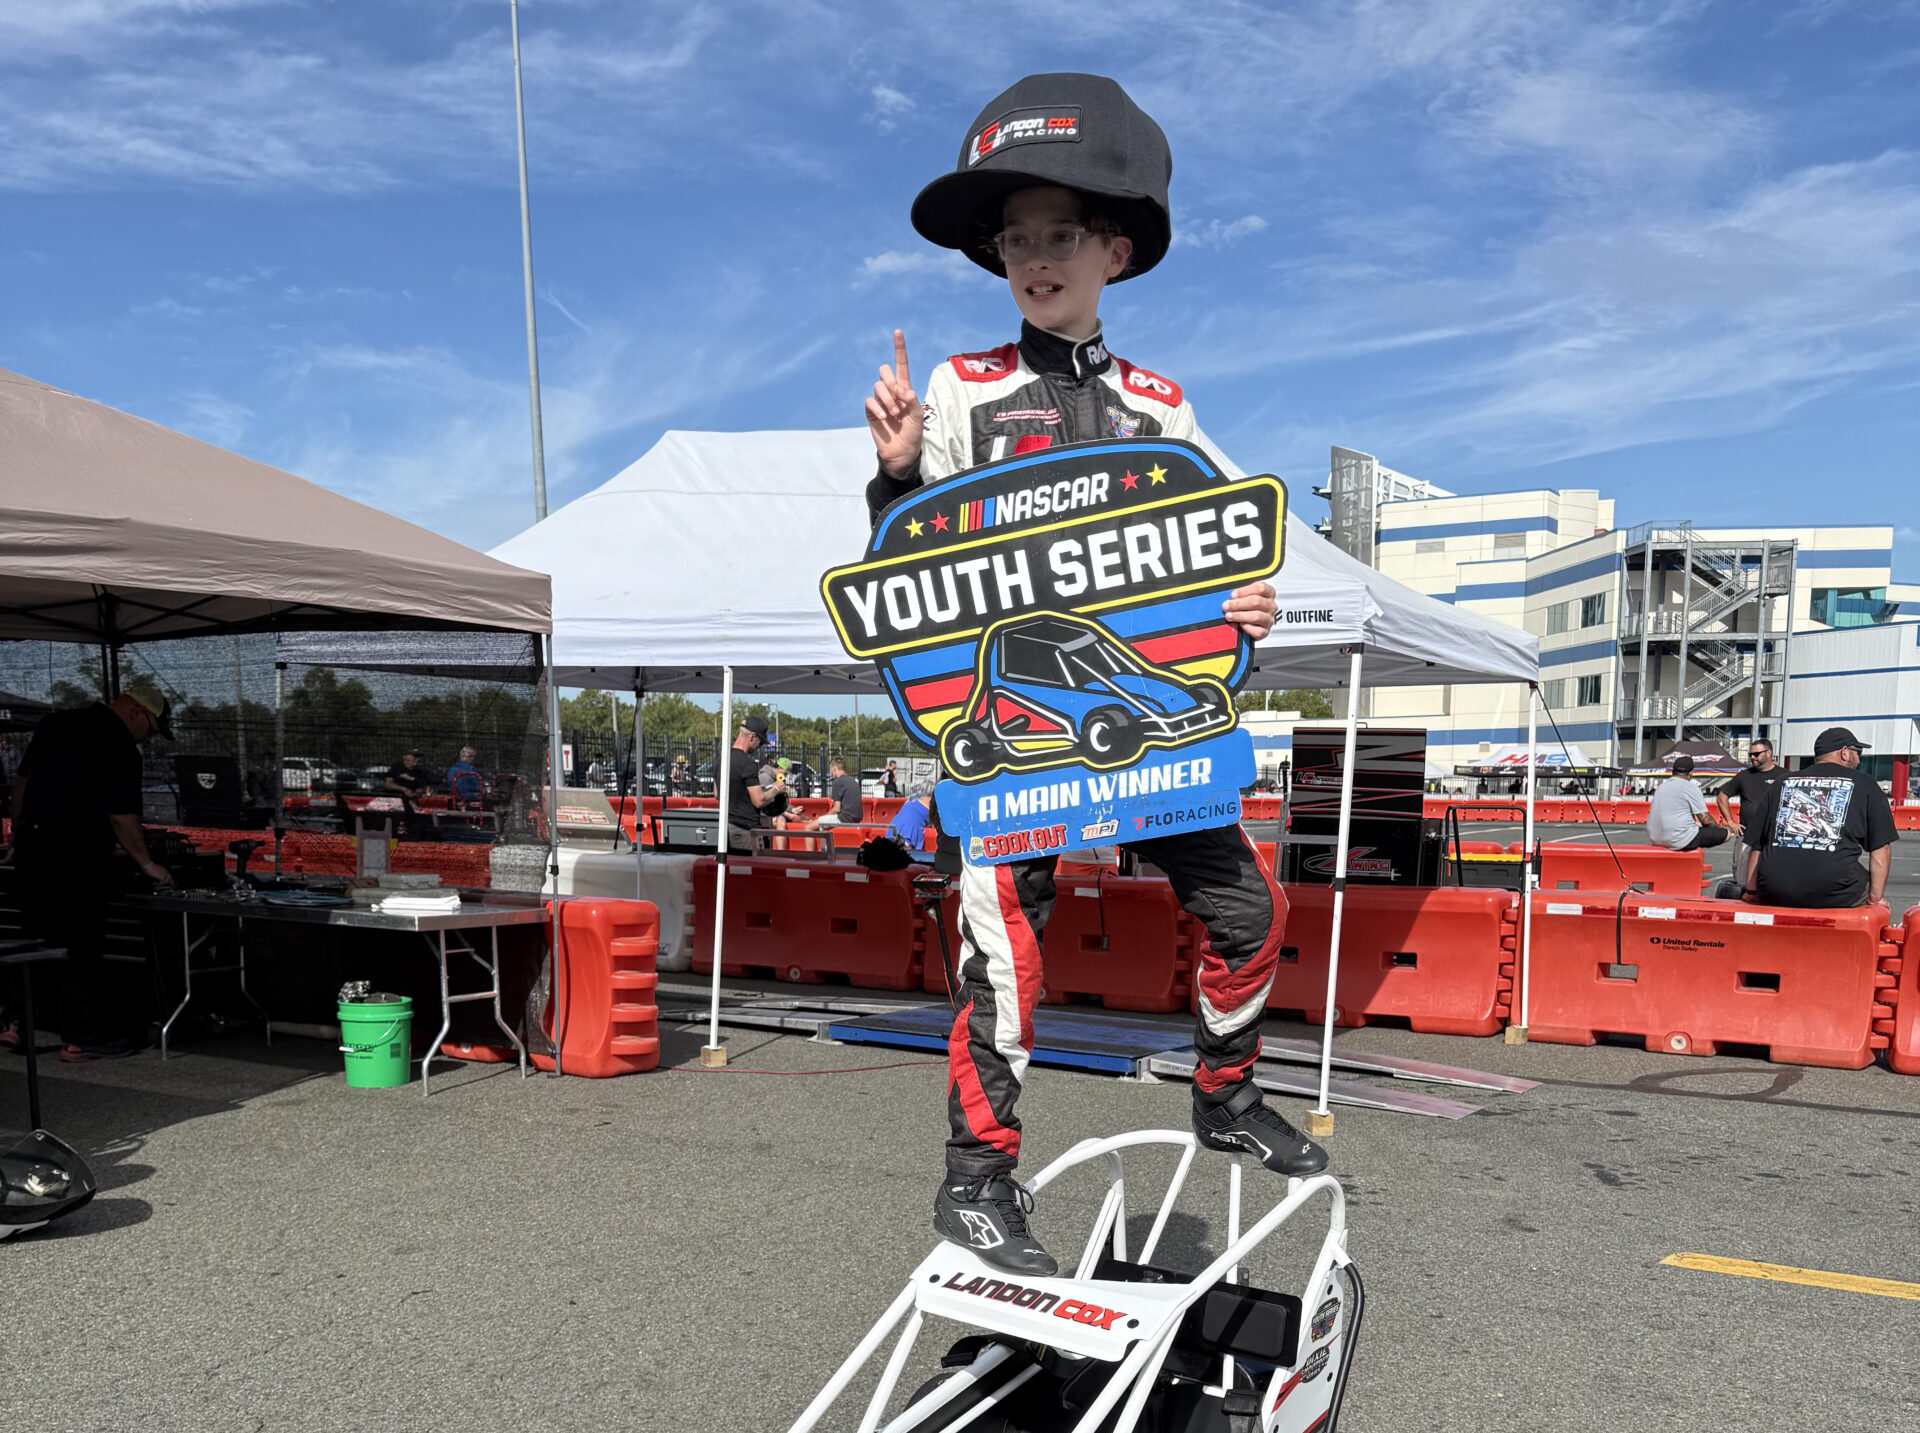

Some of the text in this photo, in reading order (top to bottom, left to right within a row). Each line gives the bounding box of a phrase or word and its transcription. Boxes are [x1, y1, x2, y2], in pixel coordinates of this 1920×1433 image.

[996, 117, 1077, 137] LANDON COX
[1013, 128, 1077, 139] RACING
[995, 472, 1109, 526] NASCAR
[844, 500, 1263, 637] YOUTH SERIES
[1286, 609, 1334, 623] OUTFINE
[979, 757, 1212, 822] A MAIN WINNER
[1783, 779, 1855, 790] WITHERS
[1145, 801, 1238, 829] FLORACING
[983, 823, 1068, 858] COOK OUT
[1662, 938, 1725, 948] United Rentals
[941, 1272, 1128, 1330] LANDON COX
